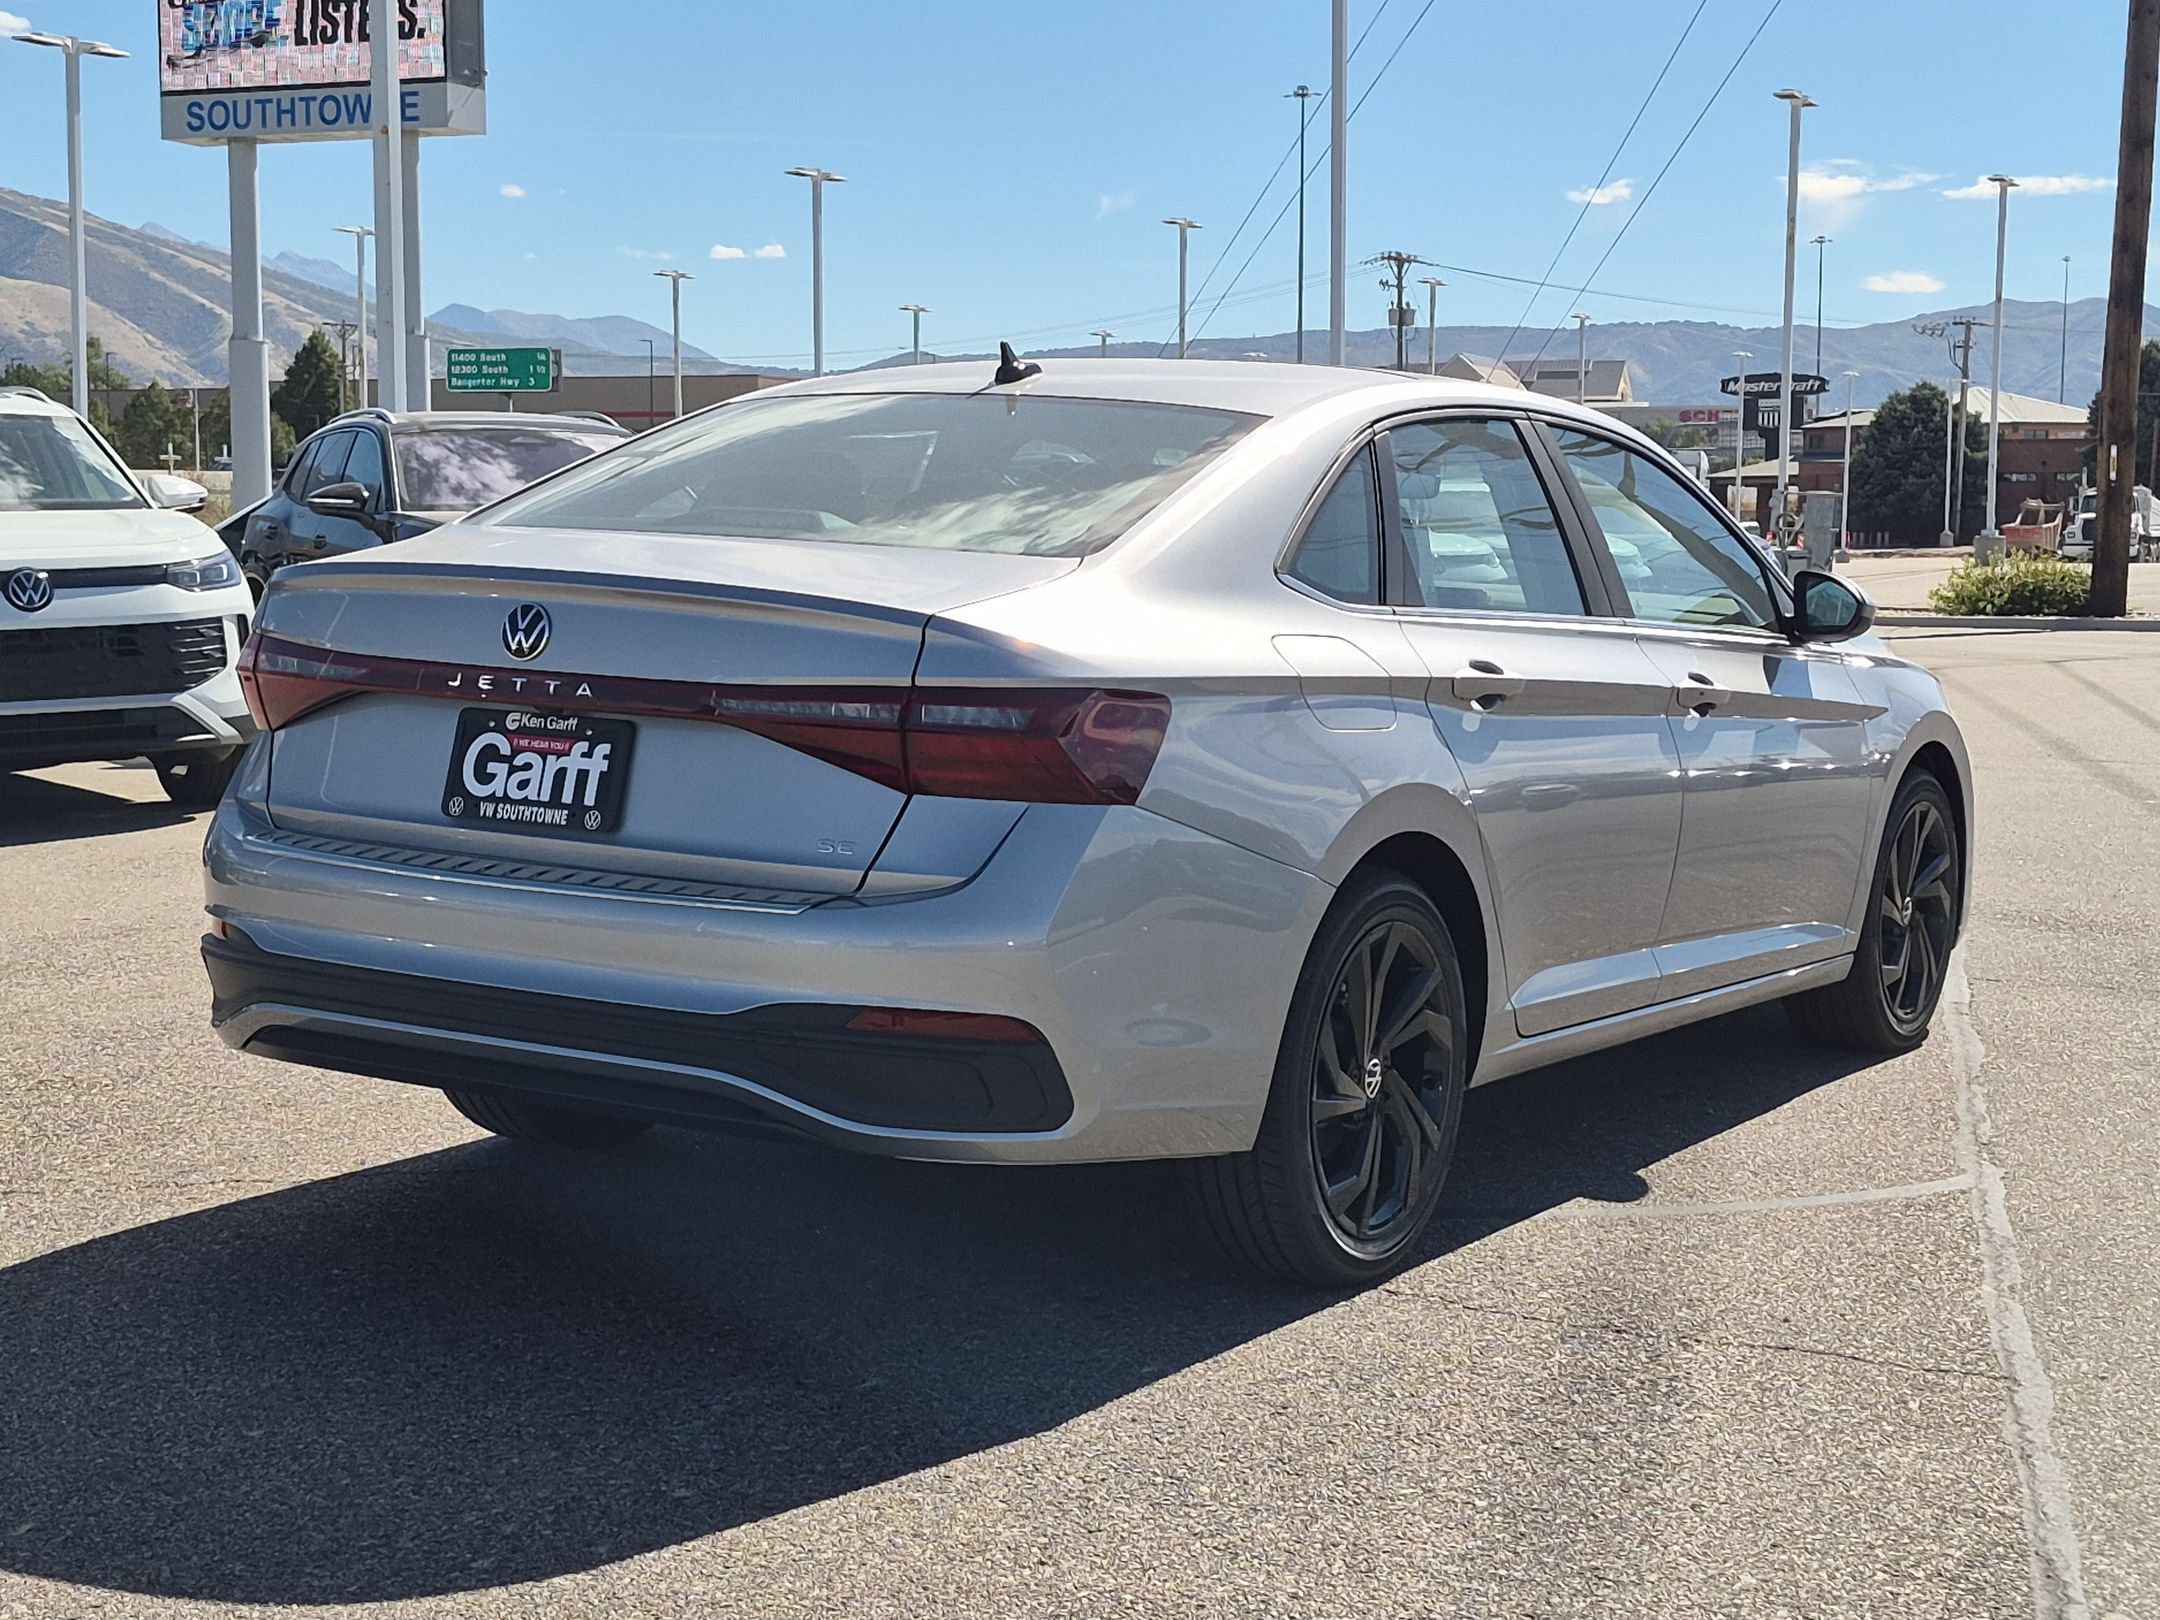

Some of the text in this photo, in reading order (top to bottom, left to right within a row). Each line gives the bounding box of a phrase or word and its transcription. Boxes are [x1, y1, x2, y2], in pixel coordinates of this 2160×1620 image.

[294, 0, 426, 46] LISTES.
[186, 91, 420, 132] SOUTHTOWE
[480, 353, 507, 362] South
[451, 365, 478, 374] 12300
[482, 365, 509, 374] South
[451, 377, 536, 388] Bangerter Hwy 3
[1727, 379, 1821, 392] Masterraft
[448, 672, 592, 697] JETTA
[521, 714, 545, 729] Ken
[547, 716, 578, 732] Garff
[463, 732, 611, 806] Garff
[480, 801, 569, 826] VW SOUTHTOWNE
[817, 840, 855, 855] SE
